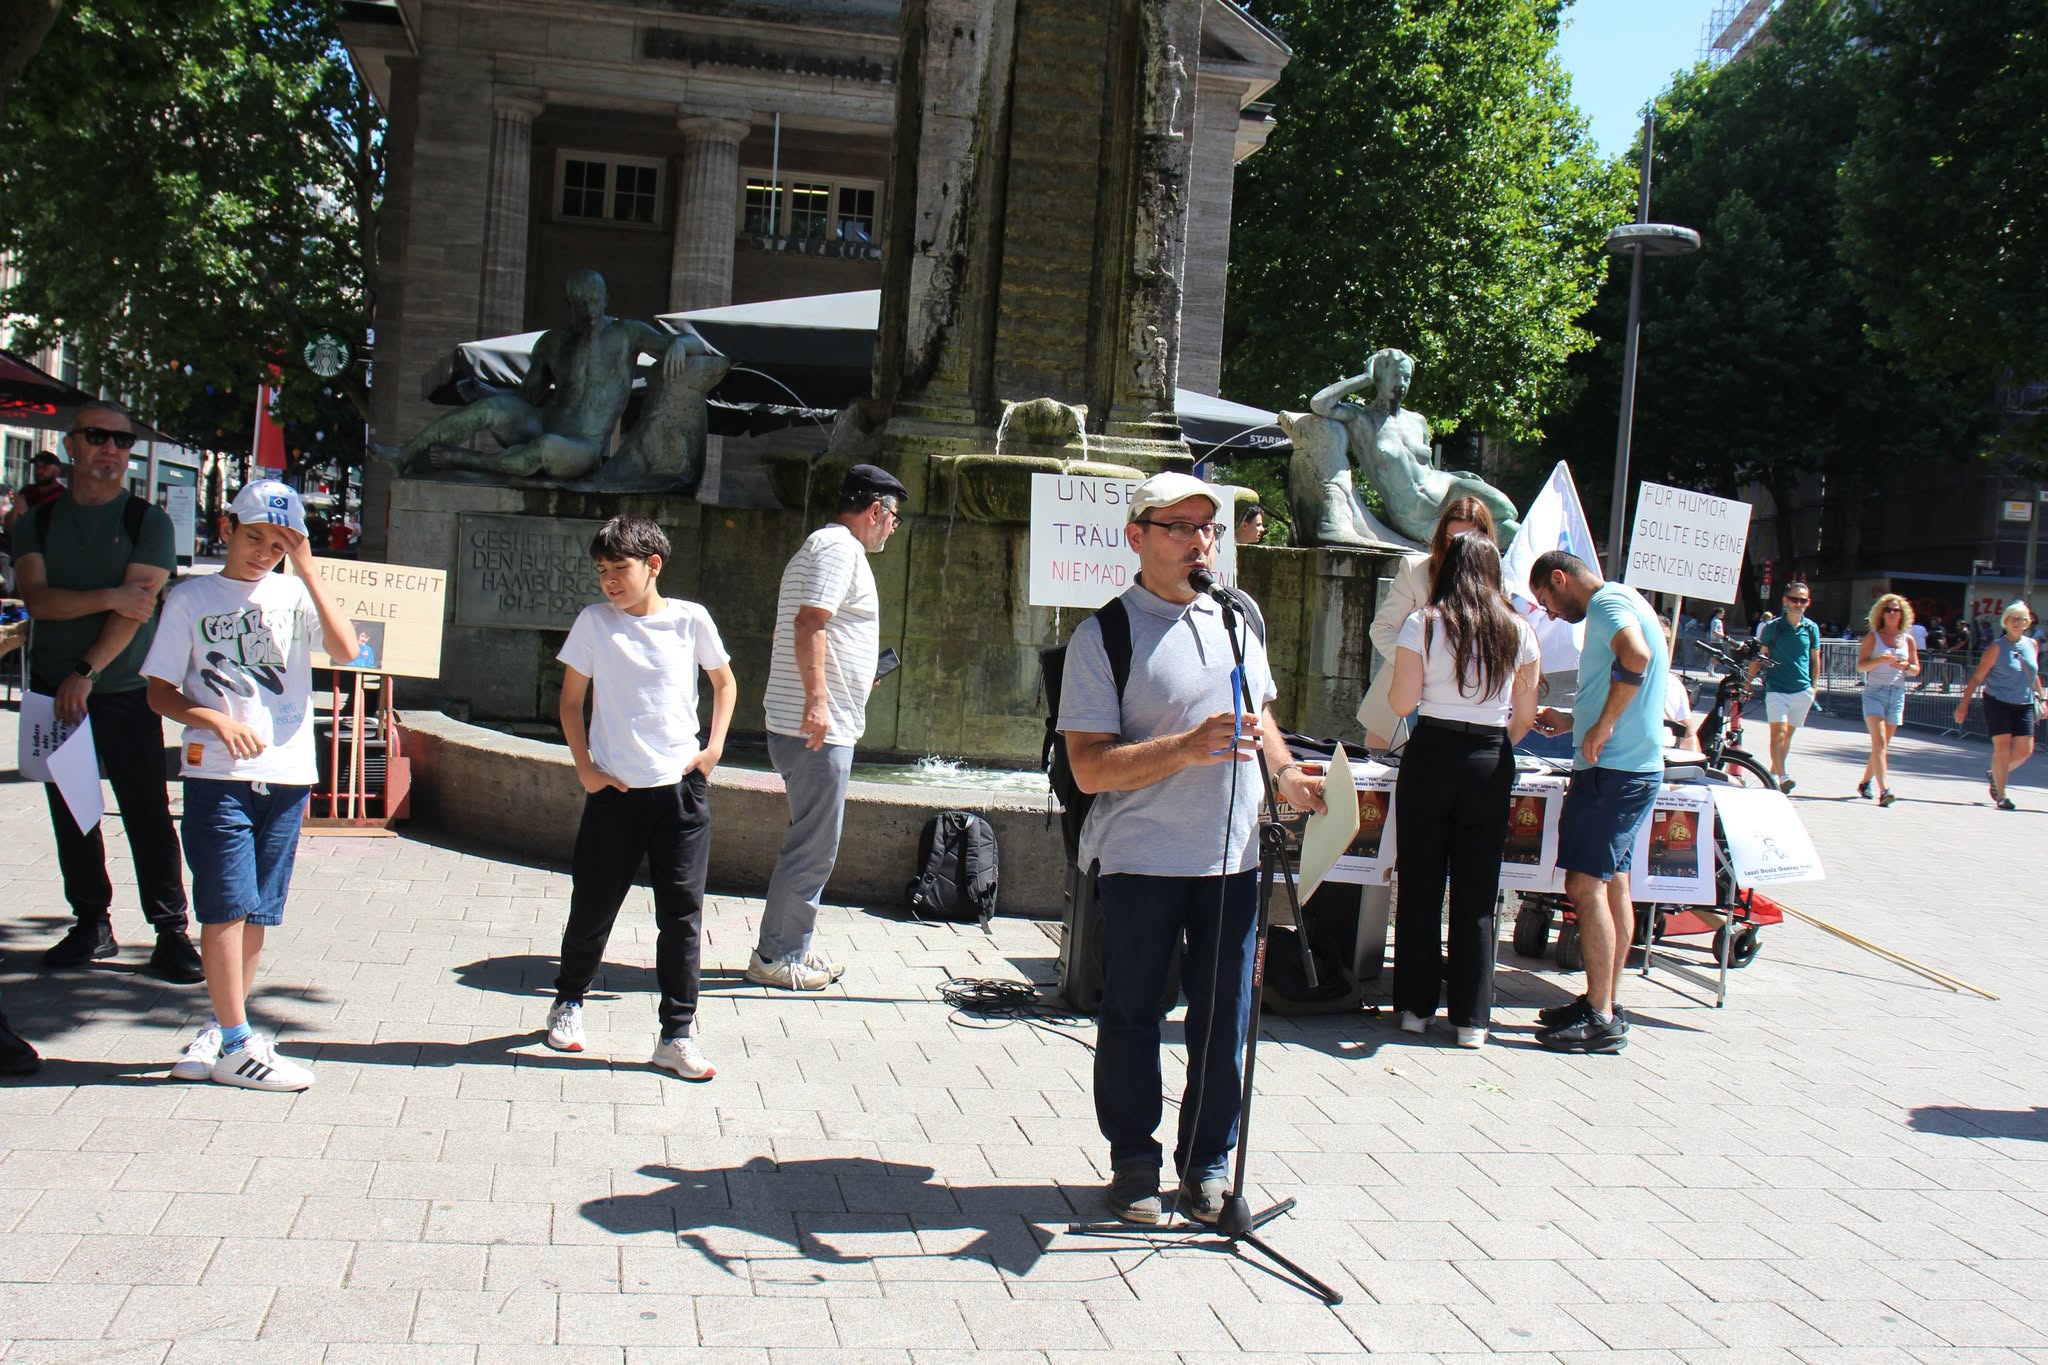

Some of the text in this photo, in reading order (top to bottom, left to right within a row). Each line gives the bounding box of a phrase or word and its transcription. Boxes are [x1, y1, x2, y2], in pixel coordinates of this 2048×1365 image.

[752, 234, 881, 262] STARBUC
[1249, 434, 1291, 445] STARBU
[1057, 478, 1136, 505] UNSE
[1678, 493, 1728, 519] HUMOR
[1053, 522, 1127, 549] TRÄU
[1640, 519, 1745, 554] SOLLTE ES KEINE
[473, 551, 514, 570] DEN
[1633, 551, 1694, 577] GRENZEN
[320, 564, 444, 593] EICHES RECHT
[355, 600, 399, 619] ALLE
